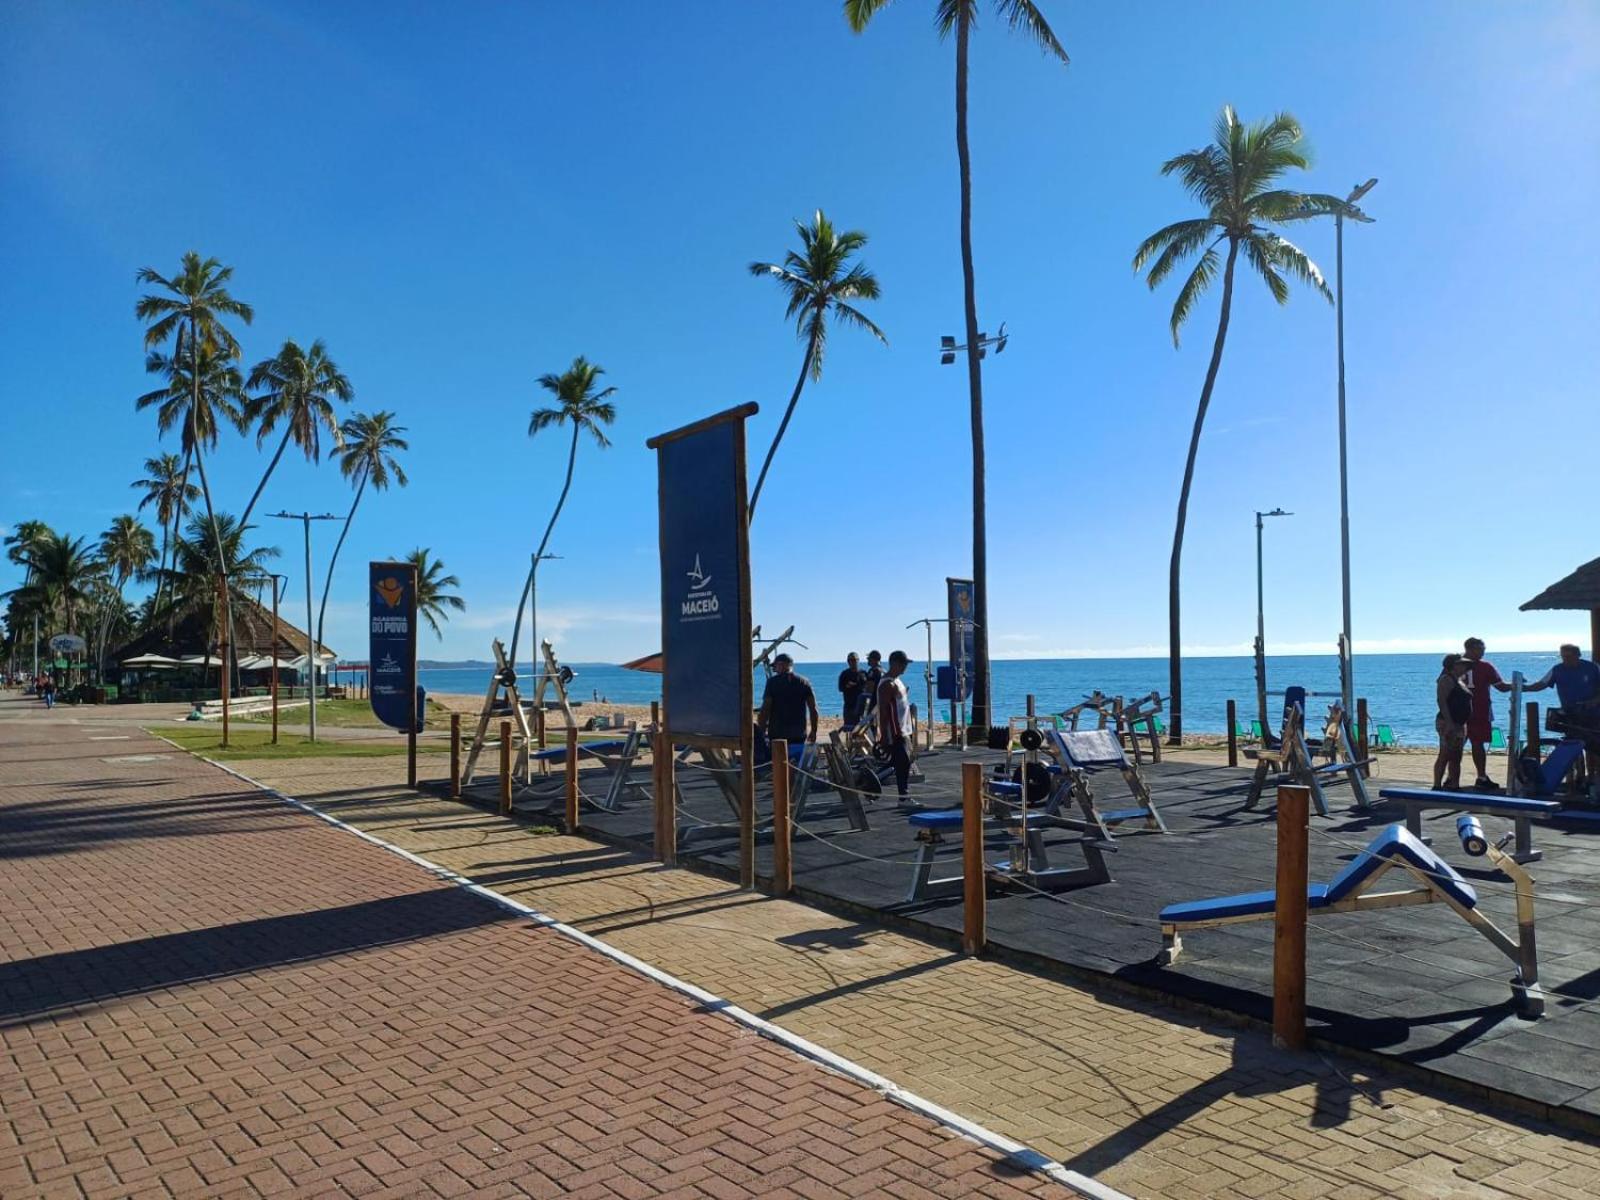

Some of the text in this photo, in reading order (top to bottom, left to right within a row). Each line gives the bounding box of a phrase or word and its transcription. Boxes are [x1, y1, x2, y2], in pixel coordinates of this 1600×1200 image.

[682, 594, 719, 616] MACEIÓ
[372, 622, 408, 633] DO POVO
